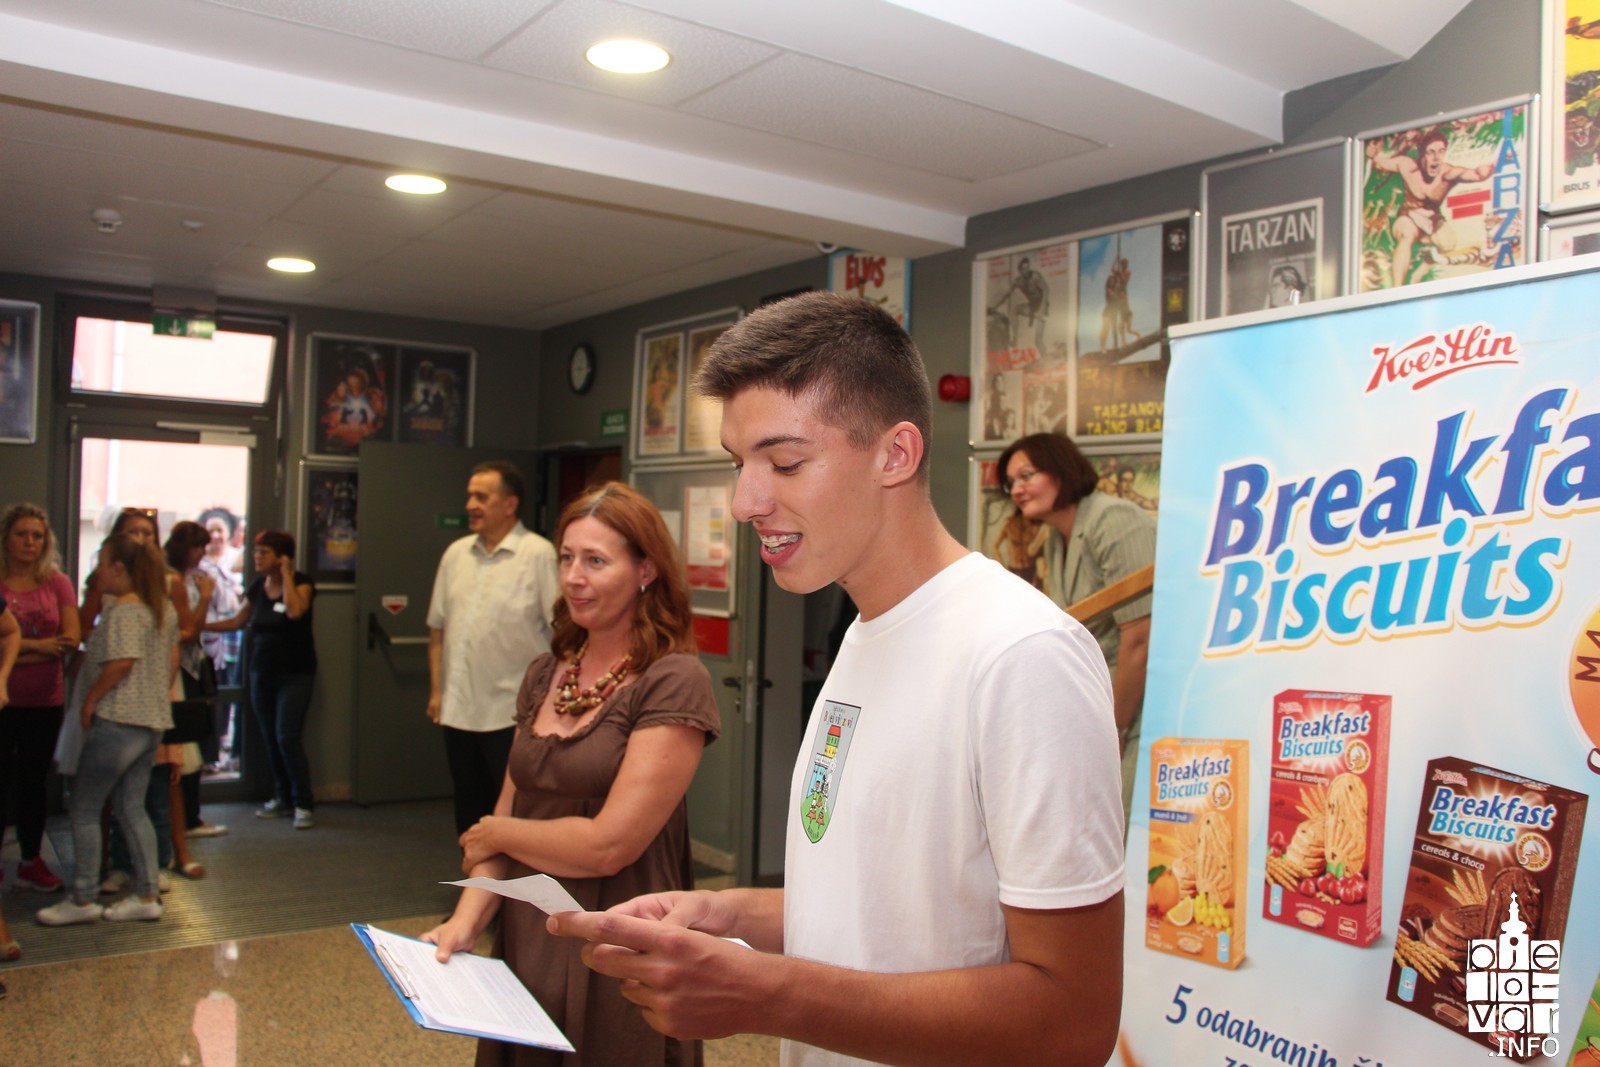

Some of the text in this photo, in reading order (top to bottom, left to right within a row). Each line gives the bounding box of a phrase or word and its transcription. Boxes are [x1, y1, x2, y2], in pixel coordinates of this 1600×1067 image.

[1563, 181, 1591, 193] BRUS
[1227, 210, 1316, 254] TARZAN
[845, 254, 887, 290] ELVIS
[1365, 325, 1519, 393] Koestlin
[1204, 388, 1600, 567] Breakfa
[1208, 517, 1562, 649] Biscuits
[1281, 712, 1369, 739] Breakfast
[1282, 735, 1343, 758] Biscuits
[1158, 757, 1230, 782] Breakfast
[1159, 778, 1209, 800] Biscuits
[1432, 788, 1554, 827] Breakfast
[1431, 811, 1516, 843] Biscuits
[1421, 843, 1485, 870] cereals & choco
[1166, 984, 1338, 1067] 5 odabranih
